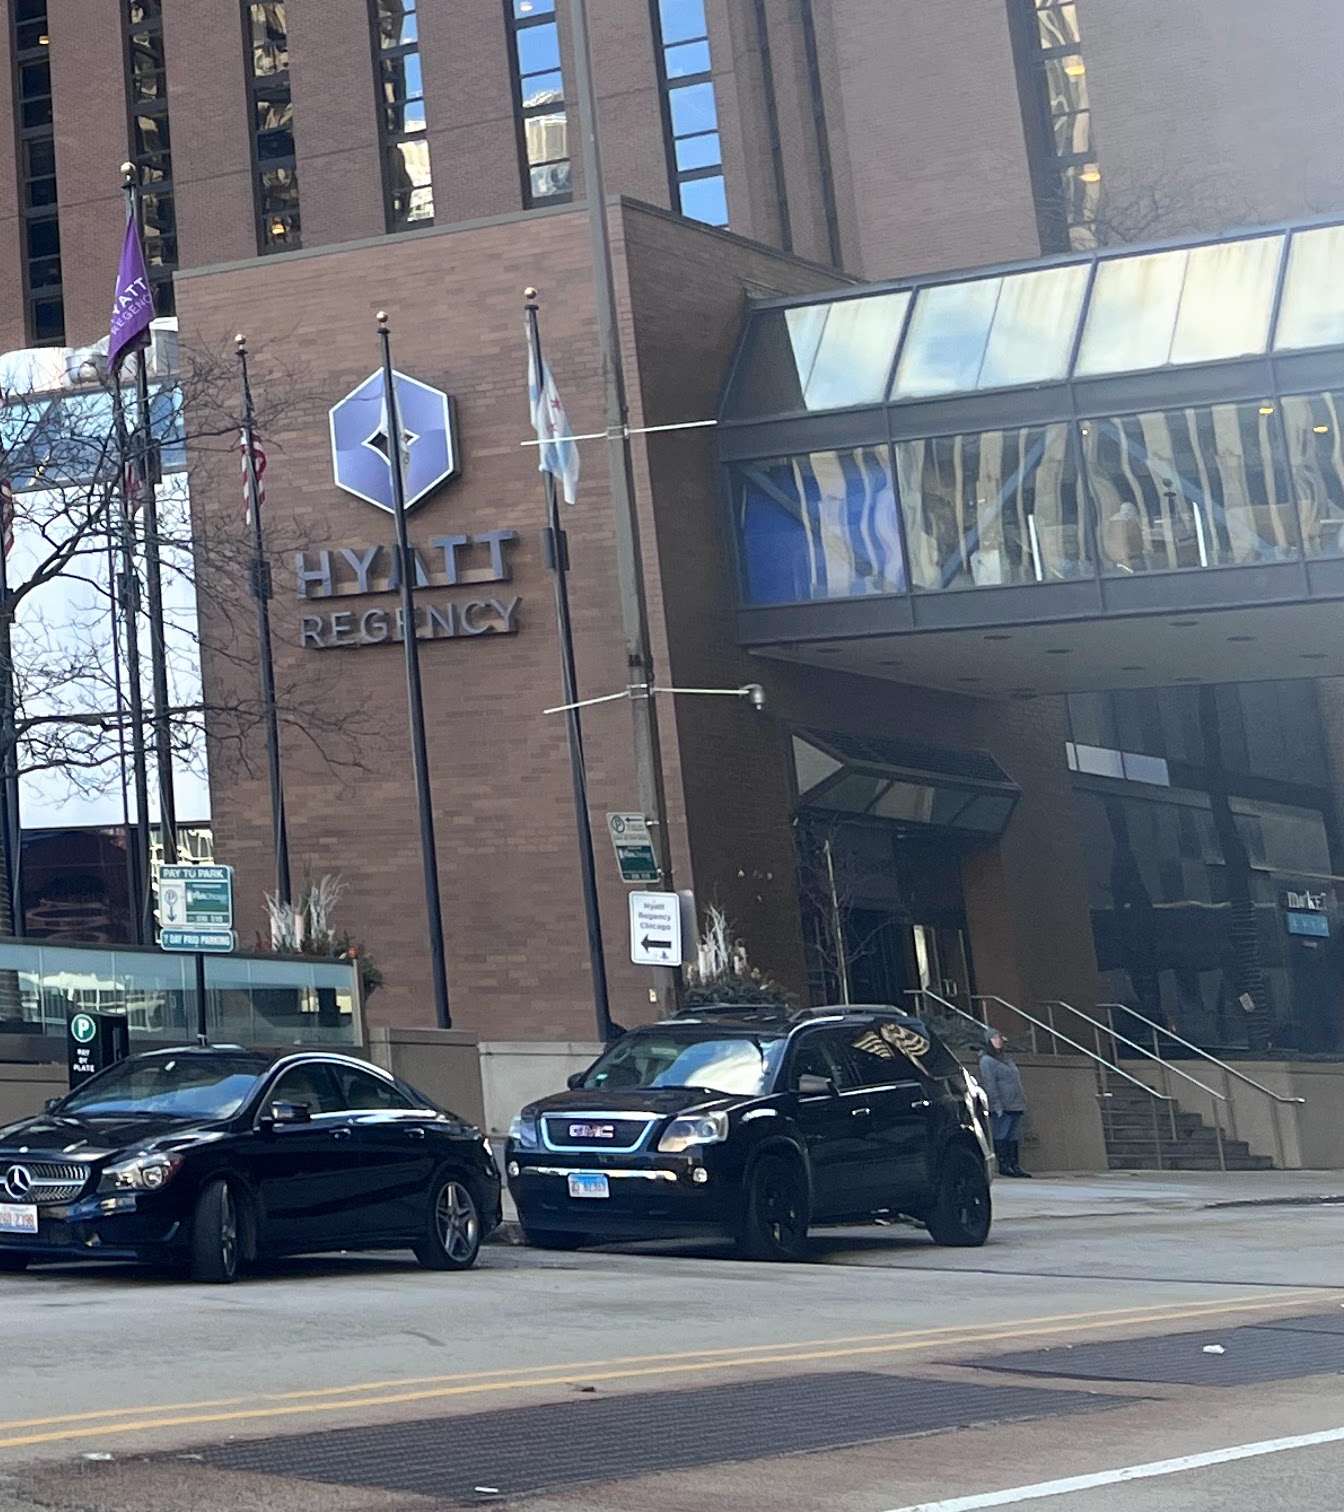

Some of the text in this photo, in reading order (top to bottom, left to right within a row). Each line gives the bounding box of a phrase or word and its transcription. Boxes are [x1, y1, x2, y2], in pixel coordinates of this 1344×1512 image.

[295, 529, 518, 599] HYATT
[300, 596, 522, 649] REGENCY
[162, 868, 224, 879] PAY TO PARK
[569, 1124, 615, 1138] GMC
